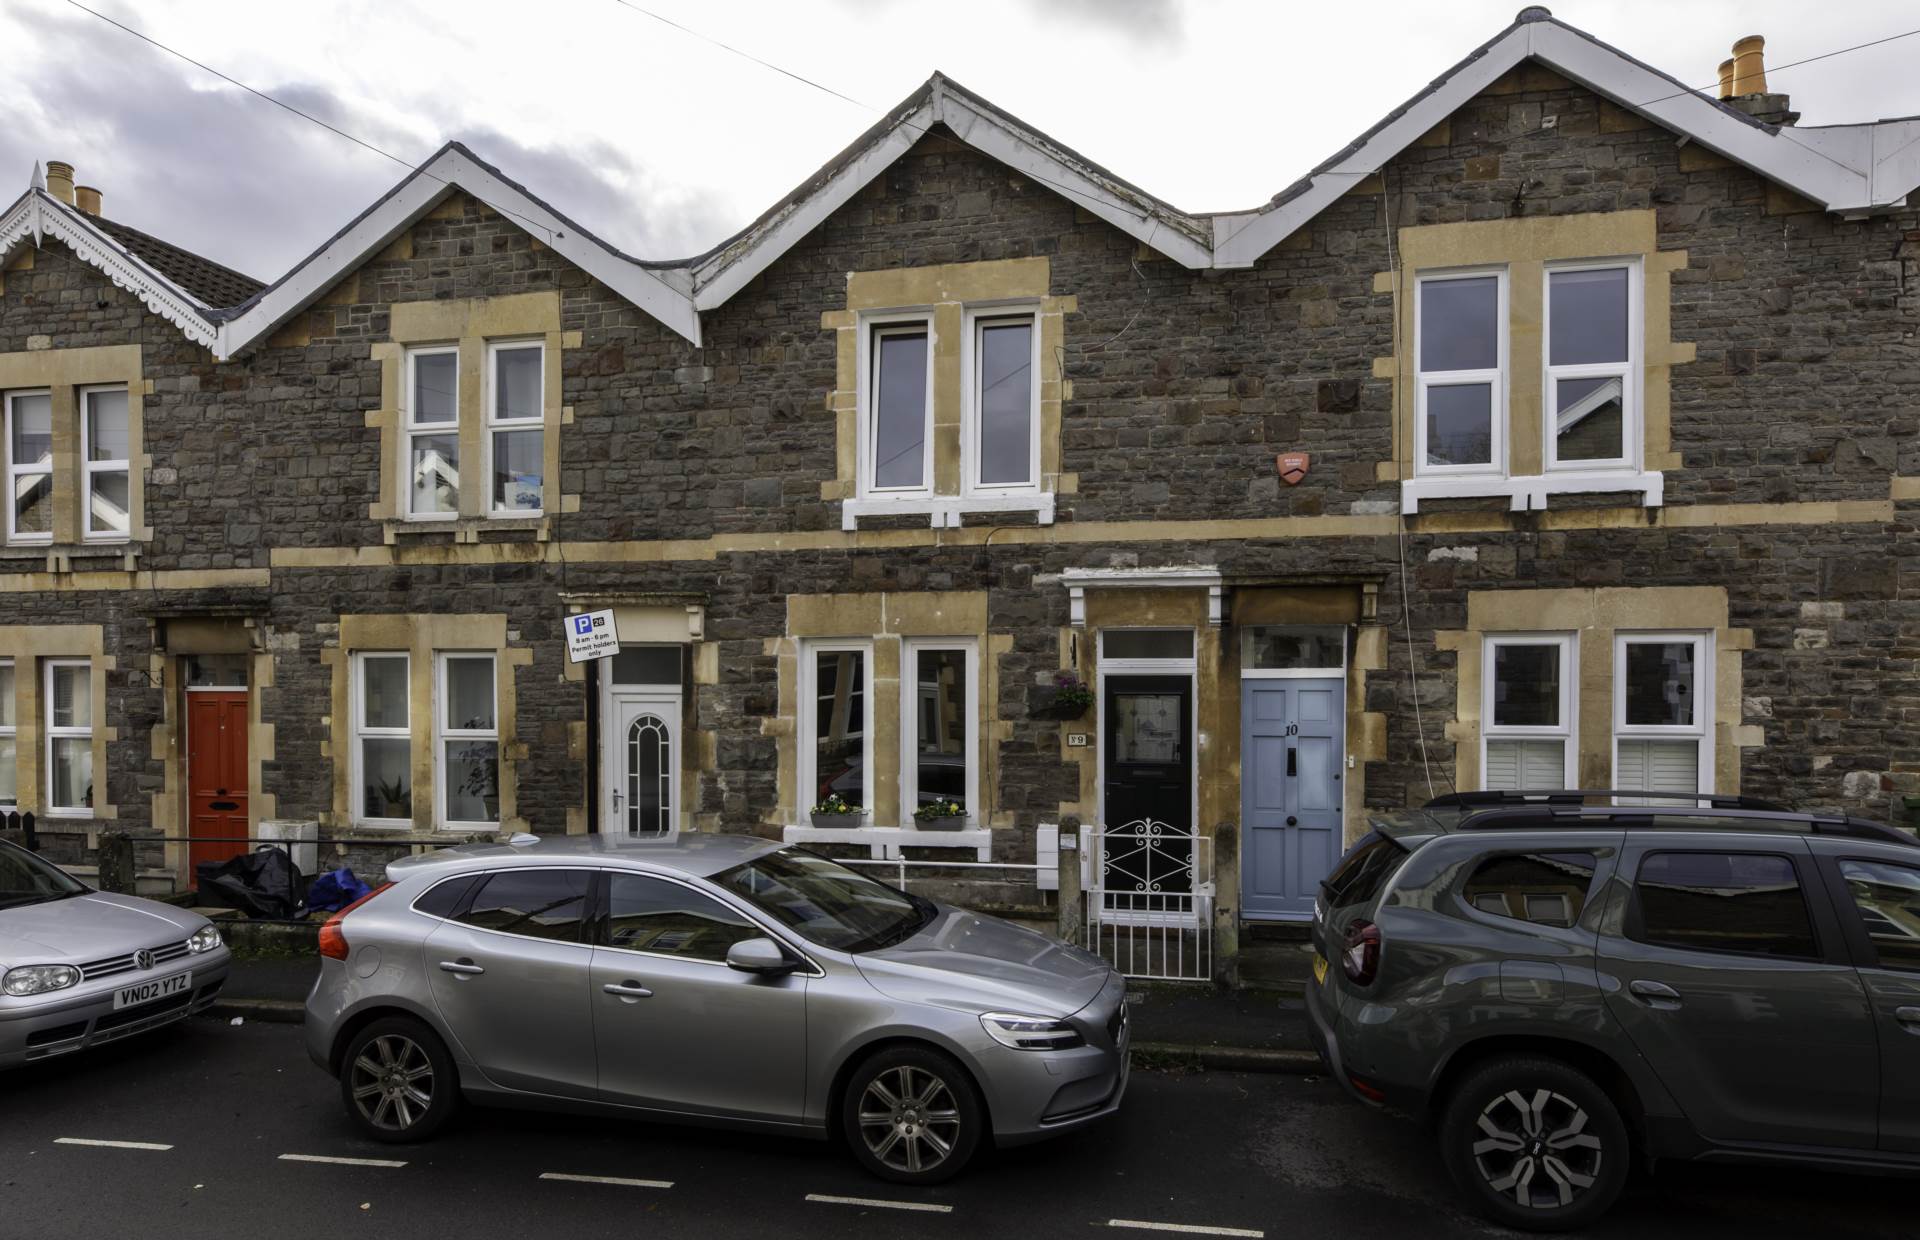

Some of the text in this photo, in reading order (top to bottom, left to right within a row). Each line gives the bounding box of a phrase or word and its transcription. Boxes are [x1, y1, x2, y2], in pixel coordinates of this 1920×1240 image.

[578, 617, 589, 632] P
[572, 641, 616, 653] Permit holders
[1285, 724, 1298, 736] 10
[121, 974, 187, 1005] VN02 YTZ
